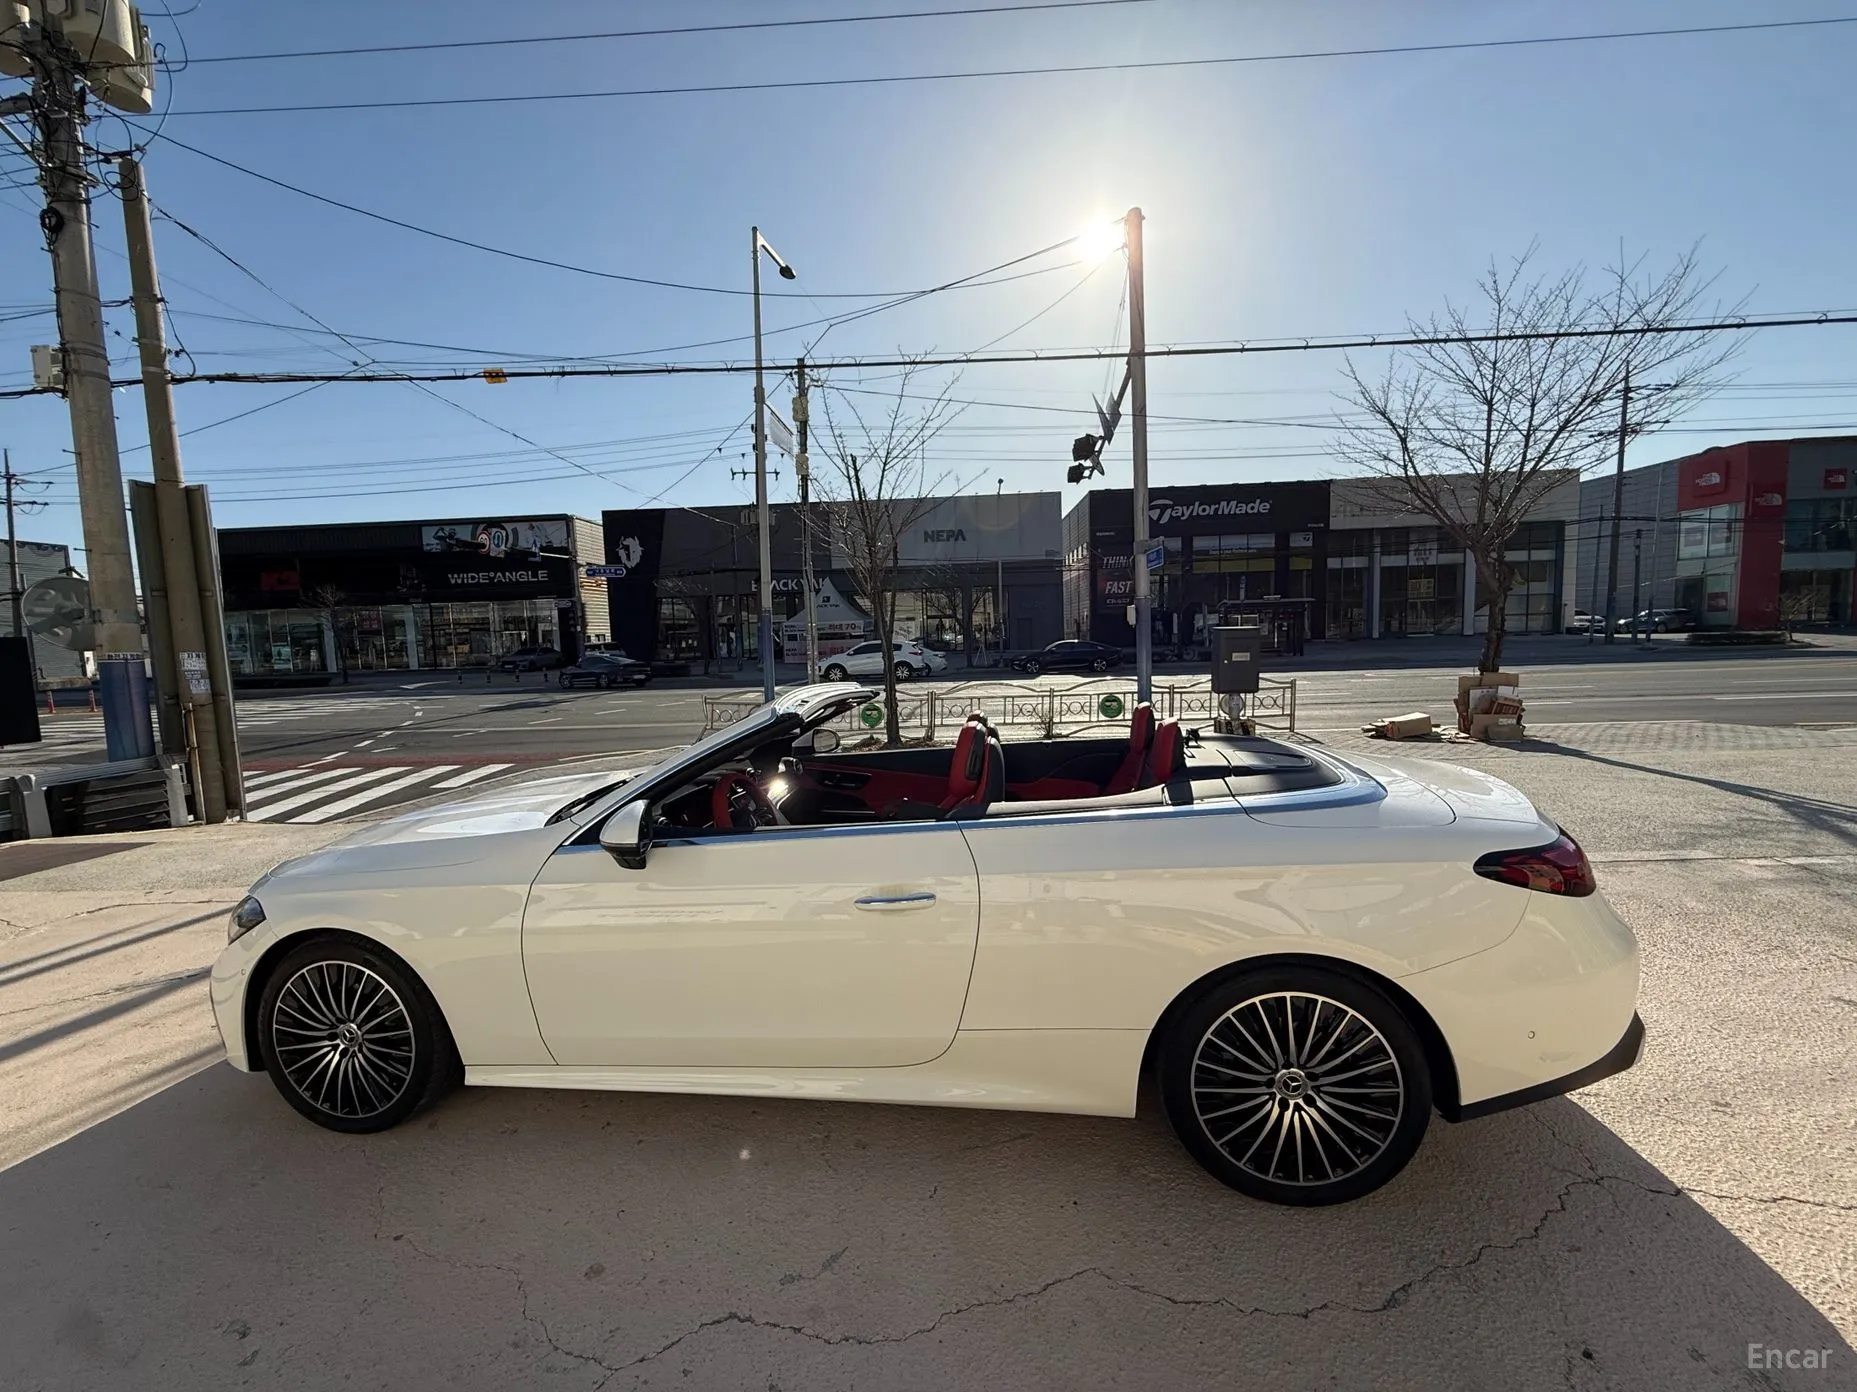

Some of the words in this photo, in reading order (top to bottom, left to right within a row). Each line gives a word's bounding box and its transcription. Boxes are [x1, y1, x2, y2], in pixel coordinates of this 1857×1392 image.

[1149, 499, 1270, 524] TaylorMade
[923, 529, 967, 543] NEPA
[751, 579, 798, 592] BACK
[1105, 580, 1133, 594] FAST
